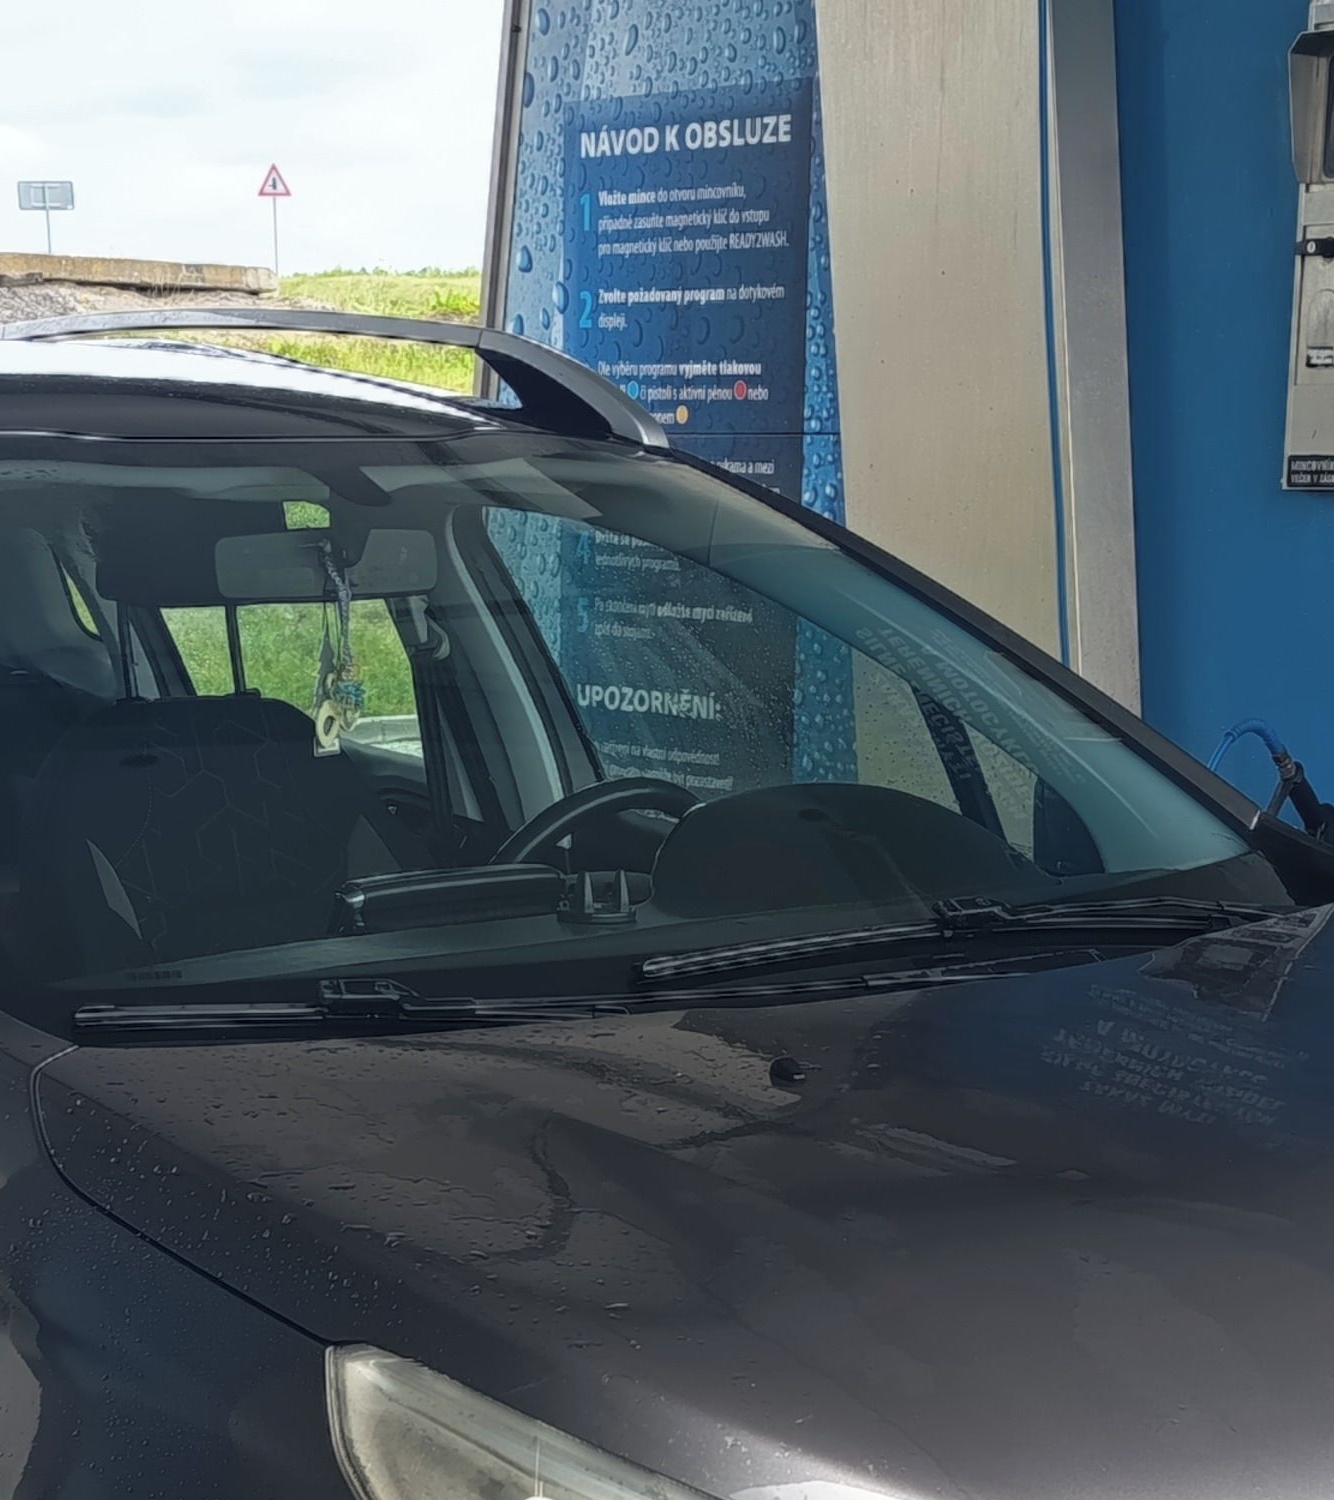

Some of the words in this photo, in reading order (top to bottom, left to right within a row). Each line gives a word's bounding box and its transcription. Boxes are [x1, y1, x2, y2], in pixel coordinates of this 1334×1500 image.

[580, 125, 660, 159] NÁVOD
[665, 124, 680, 152] K
[685, 114, 792, 150] OBSLUZE
[598, 189, 626, 206] Vložte
[628, 189, 656, 205] mince
[657, 187, 668, 202] do
[580, 192, 592, 231] 1
[729, 208, 740, 223] do
[742, 209, 770, 225] vstupu
[673, 237, 693, 252] nebo
[598, 288, 626, 305] Zvolte
[628, 286, 682, 306] požadovaný
[683, 288, 725, 306] program
[727, 288, 737, 300] na
[579, 290, 592, 328] 2
[679, 361, 717, 379] vyjměte
[719, 360, 761, 375] tlakovou
[747, 387, 768, 401] nebo
[755, 459, 774, 475] mezi
[576, 683, 721, 721] UPOZORNĚNÍ:
